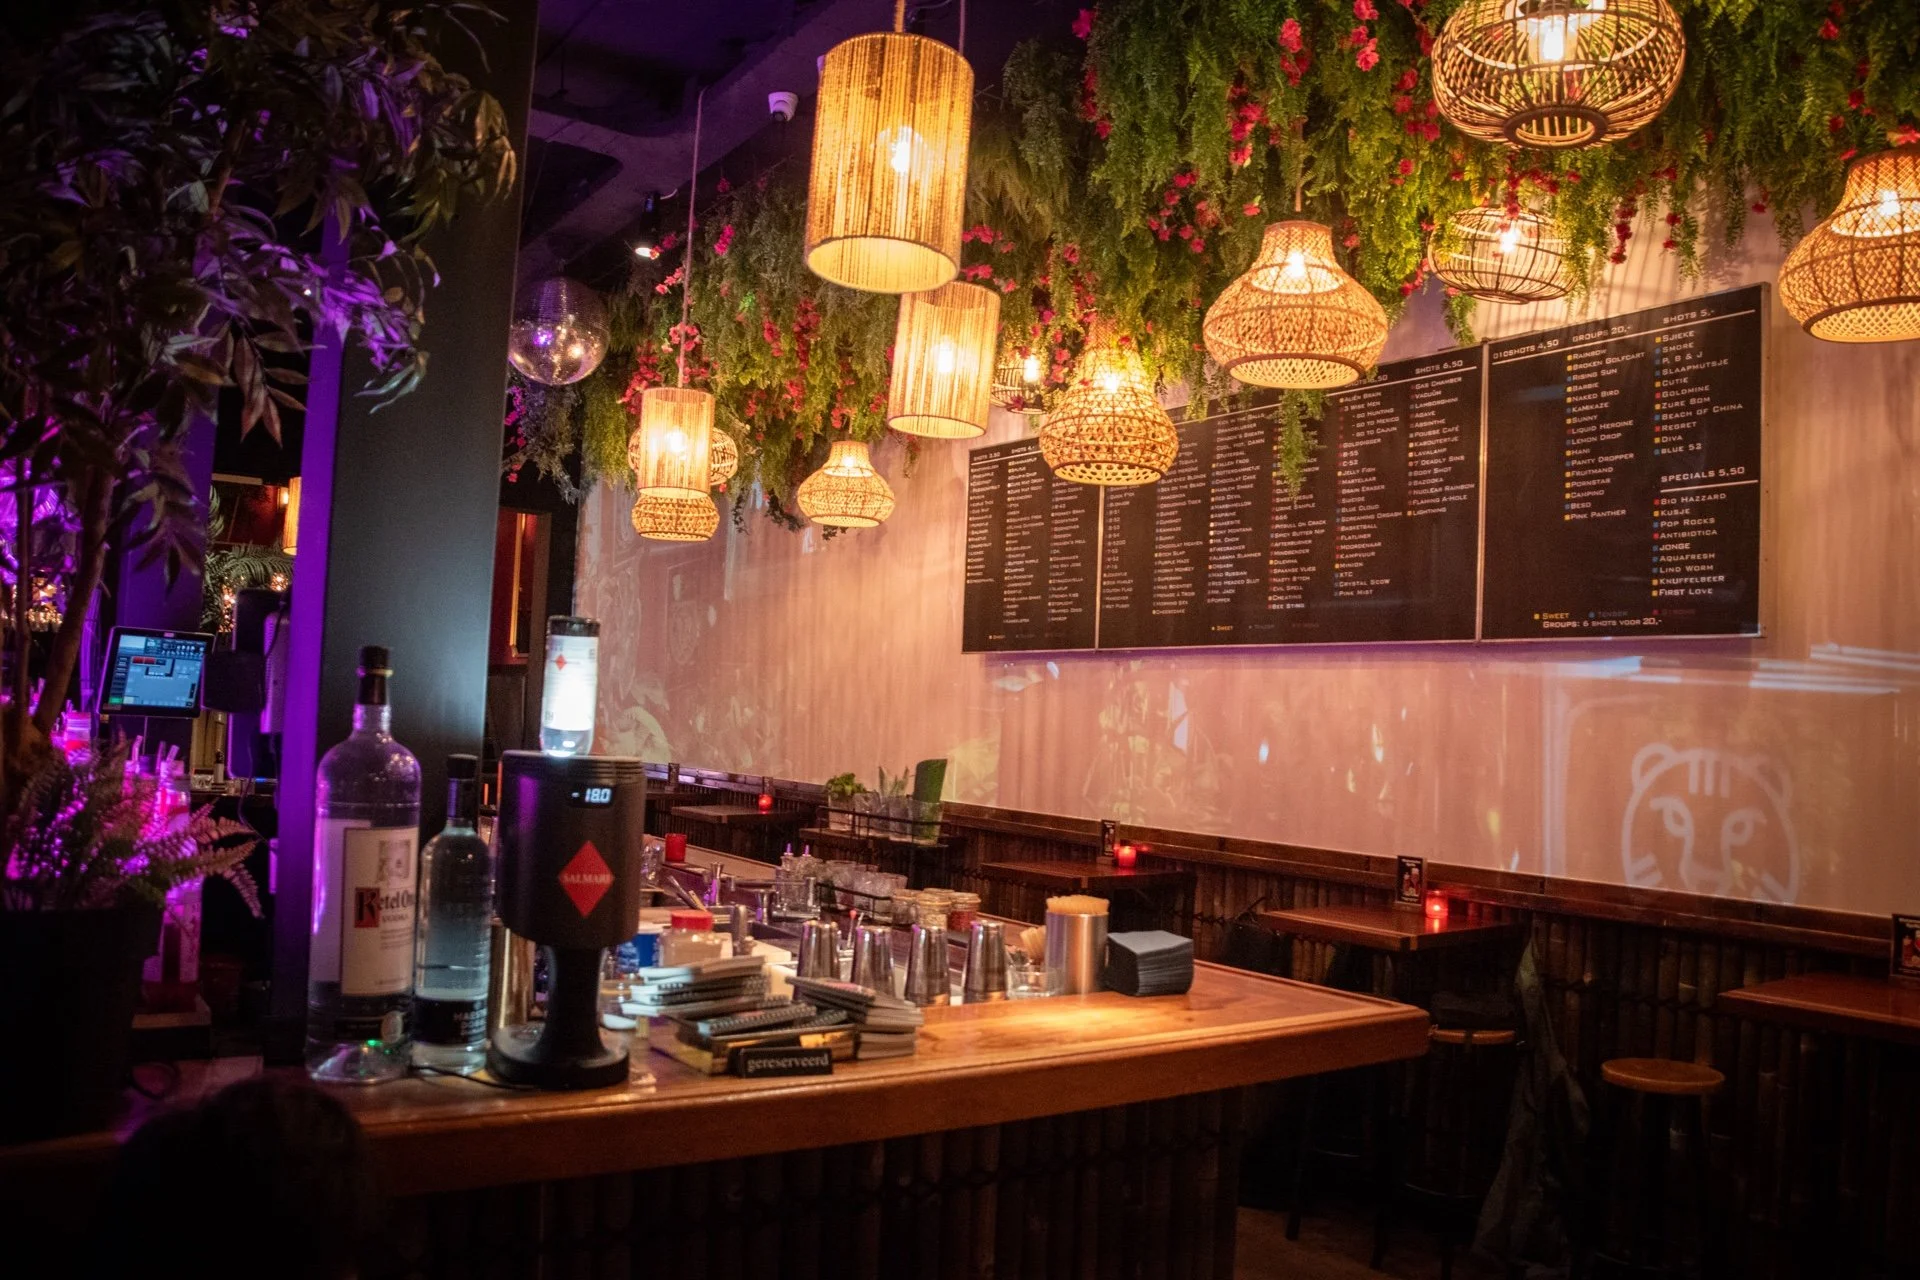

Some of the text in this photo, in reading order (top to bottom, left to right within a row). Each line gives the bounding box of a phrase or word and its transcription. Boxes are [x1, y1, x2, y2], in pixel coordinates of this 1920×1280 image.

[1663, 311, 1698, 324] SHOTS
[1572, 329, 1608, 342] GROUPS
[1572, 349, 1607, 360] RAINBOW
[1572, 352, 1646, 371] BROKEN GOLFCART
[1662, 358, 1729, 376] SLAAPMUTSJE
[1572, 368, 1618, 381] RISING SUN
[1662, 377, 1688, 386] CUTIE
[1572, 390, 1620, 402] NAKED BIRD
[1662, 384, 1710, 398] GOLDMINE
[1662, 400, 1686, 410] ZURE
[1662, 403, 1743, 420] BEACH OF CHINA
[1572, 420, 1634, 434] LIQUID HEROINE
[1662, 421, 1697, 431] REGRET
[1662, 435, 1683, 443] DIVA
[1661, 442, 1702, 454] BLUE 52
[1572, 452, 1634, 466] PANTY DROPPER
[1661, 470, 1715, 482] SPECIALS
[1680, 492, 1726, 503] HAZZARD
[1590, 510, 1626, 518] PANTHER
[1660, 508, 1690, 516] KUSJE
[1660, 518, 1716, 528] POP ROCKS
[1660, 529, 1718, 539] ANTIBIOTICA
[1660, 542, 1690, 551] JONGE
[1660, 553, 1715, 562] AQUAFRESH
[1685, 564, 1714, 572] WORM
[1660, 575, 1724, 585] KNUFFELBEER
[1659, 588, 1685, 596] FIRST
[747, 1053, 829, 1073] gereserveerd
